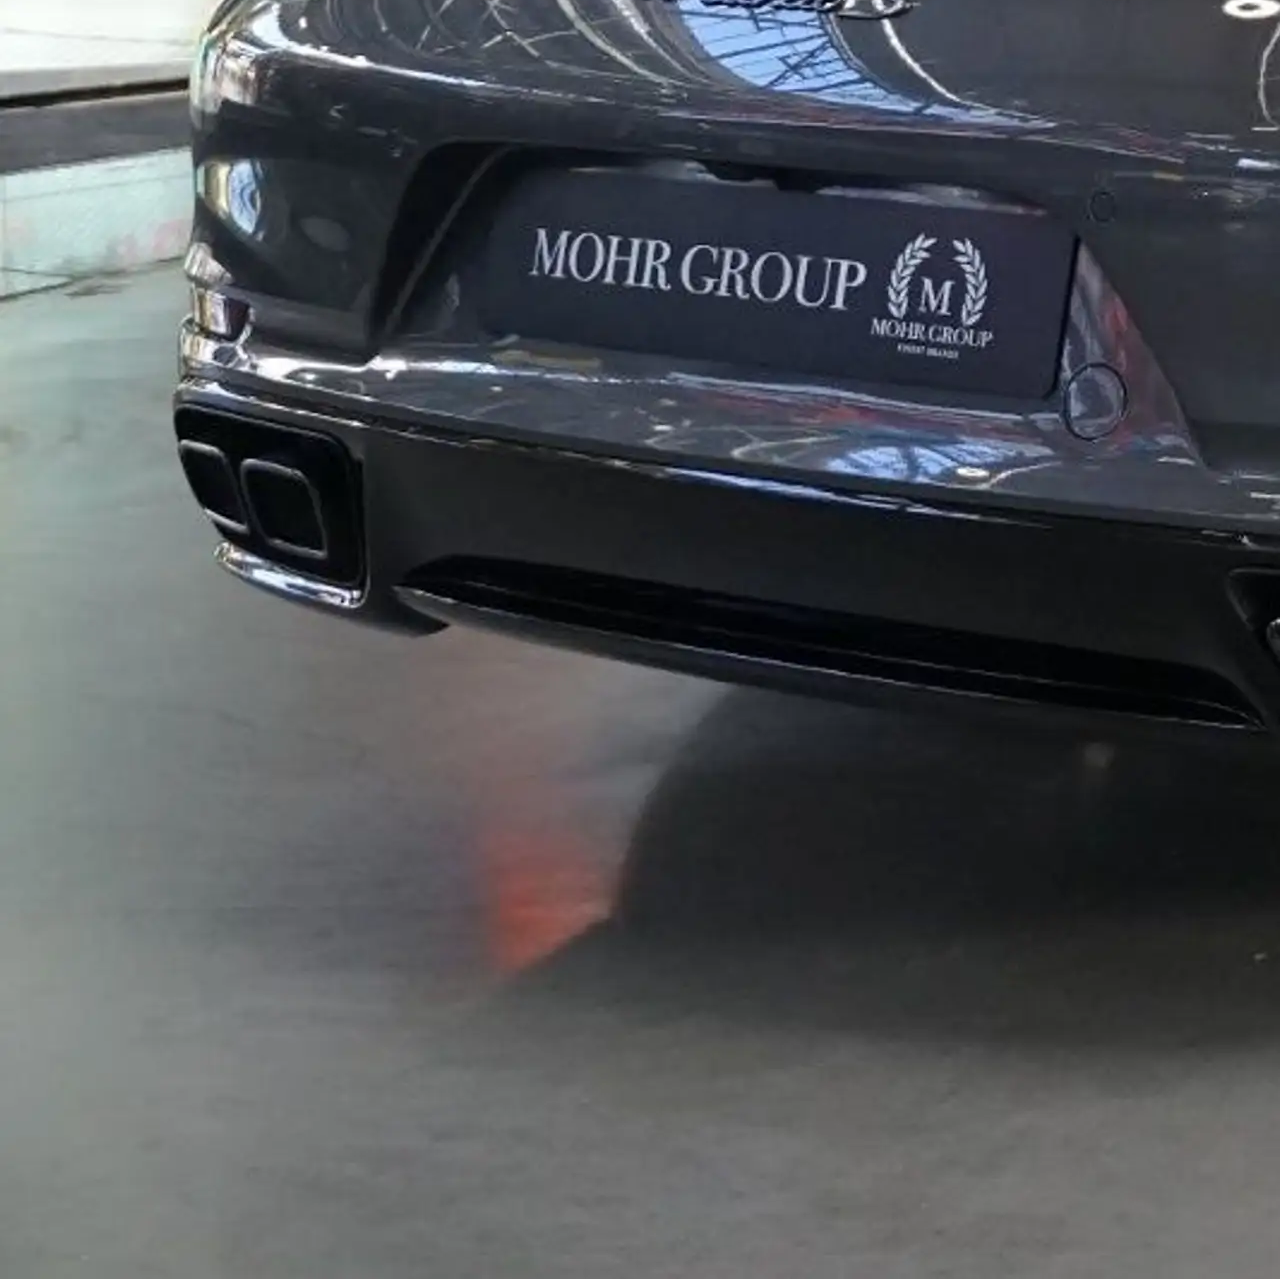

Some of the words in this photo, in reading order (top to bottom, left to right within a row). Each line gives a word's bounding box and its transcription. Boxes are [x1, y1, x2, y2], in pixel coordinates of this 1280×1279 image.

[528, 227, 671, 291] MOHR
[681, 244, 867, 310] GROUP
[918, 276, 956, 316] M
[870, 317, 925, 341] MOHR
[928, 324, 993, 348] GROUP
